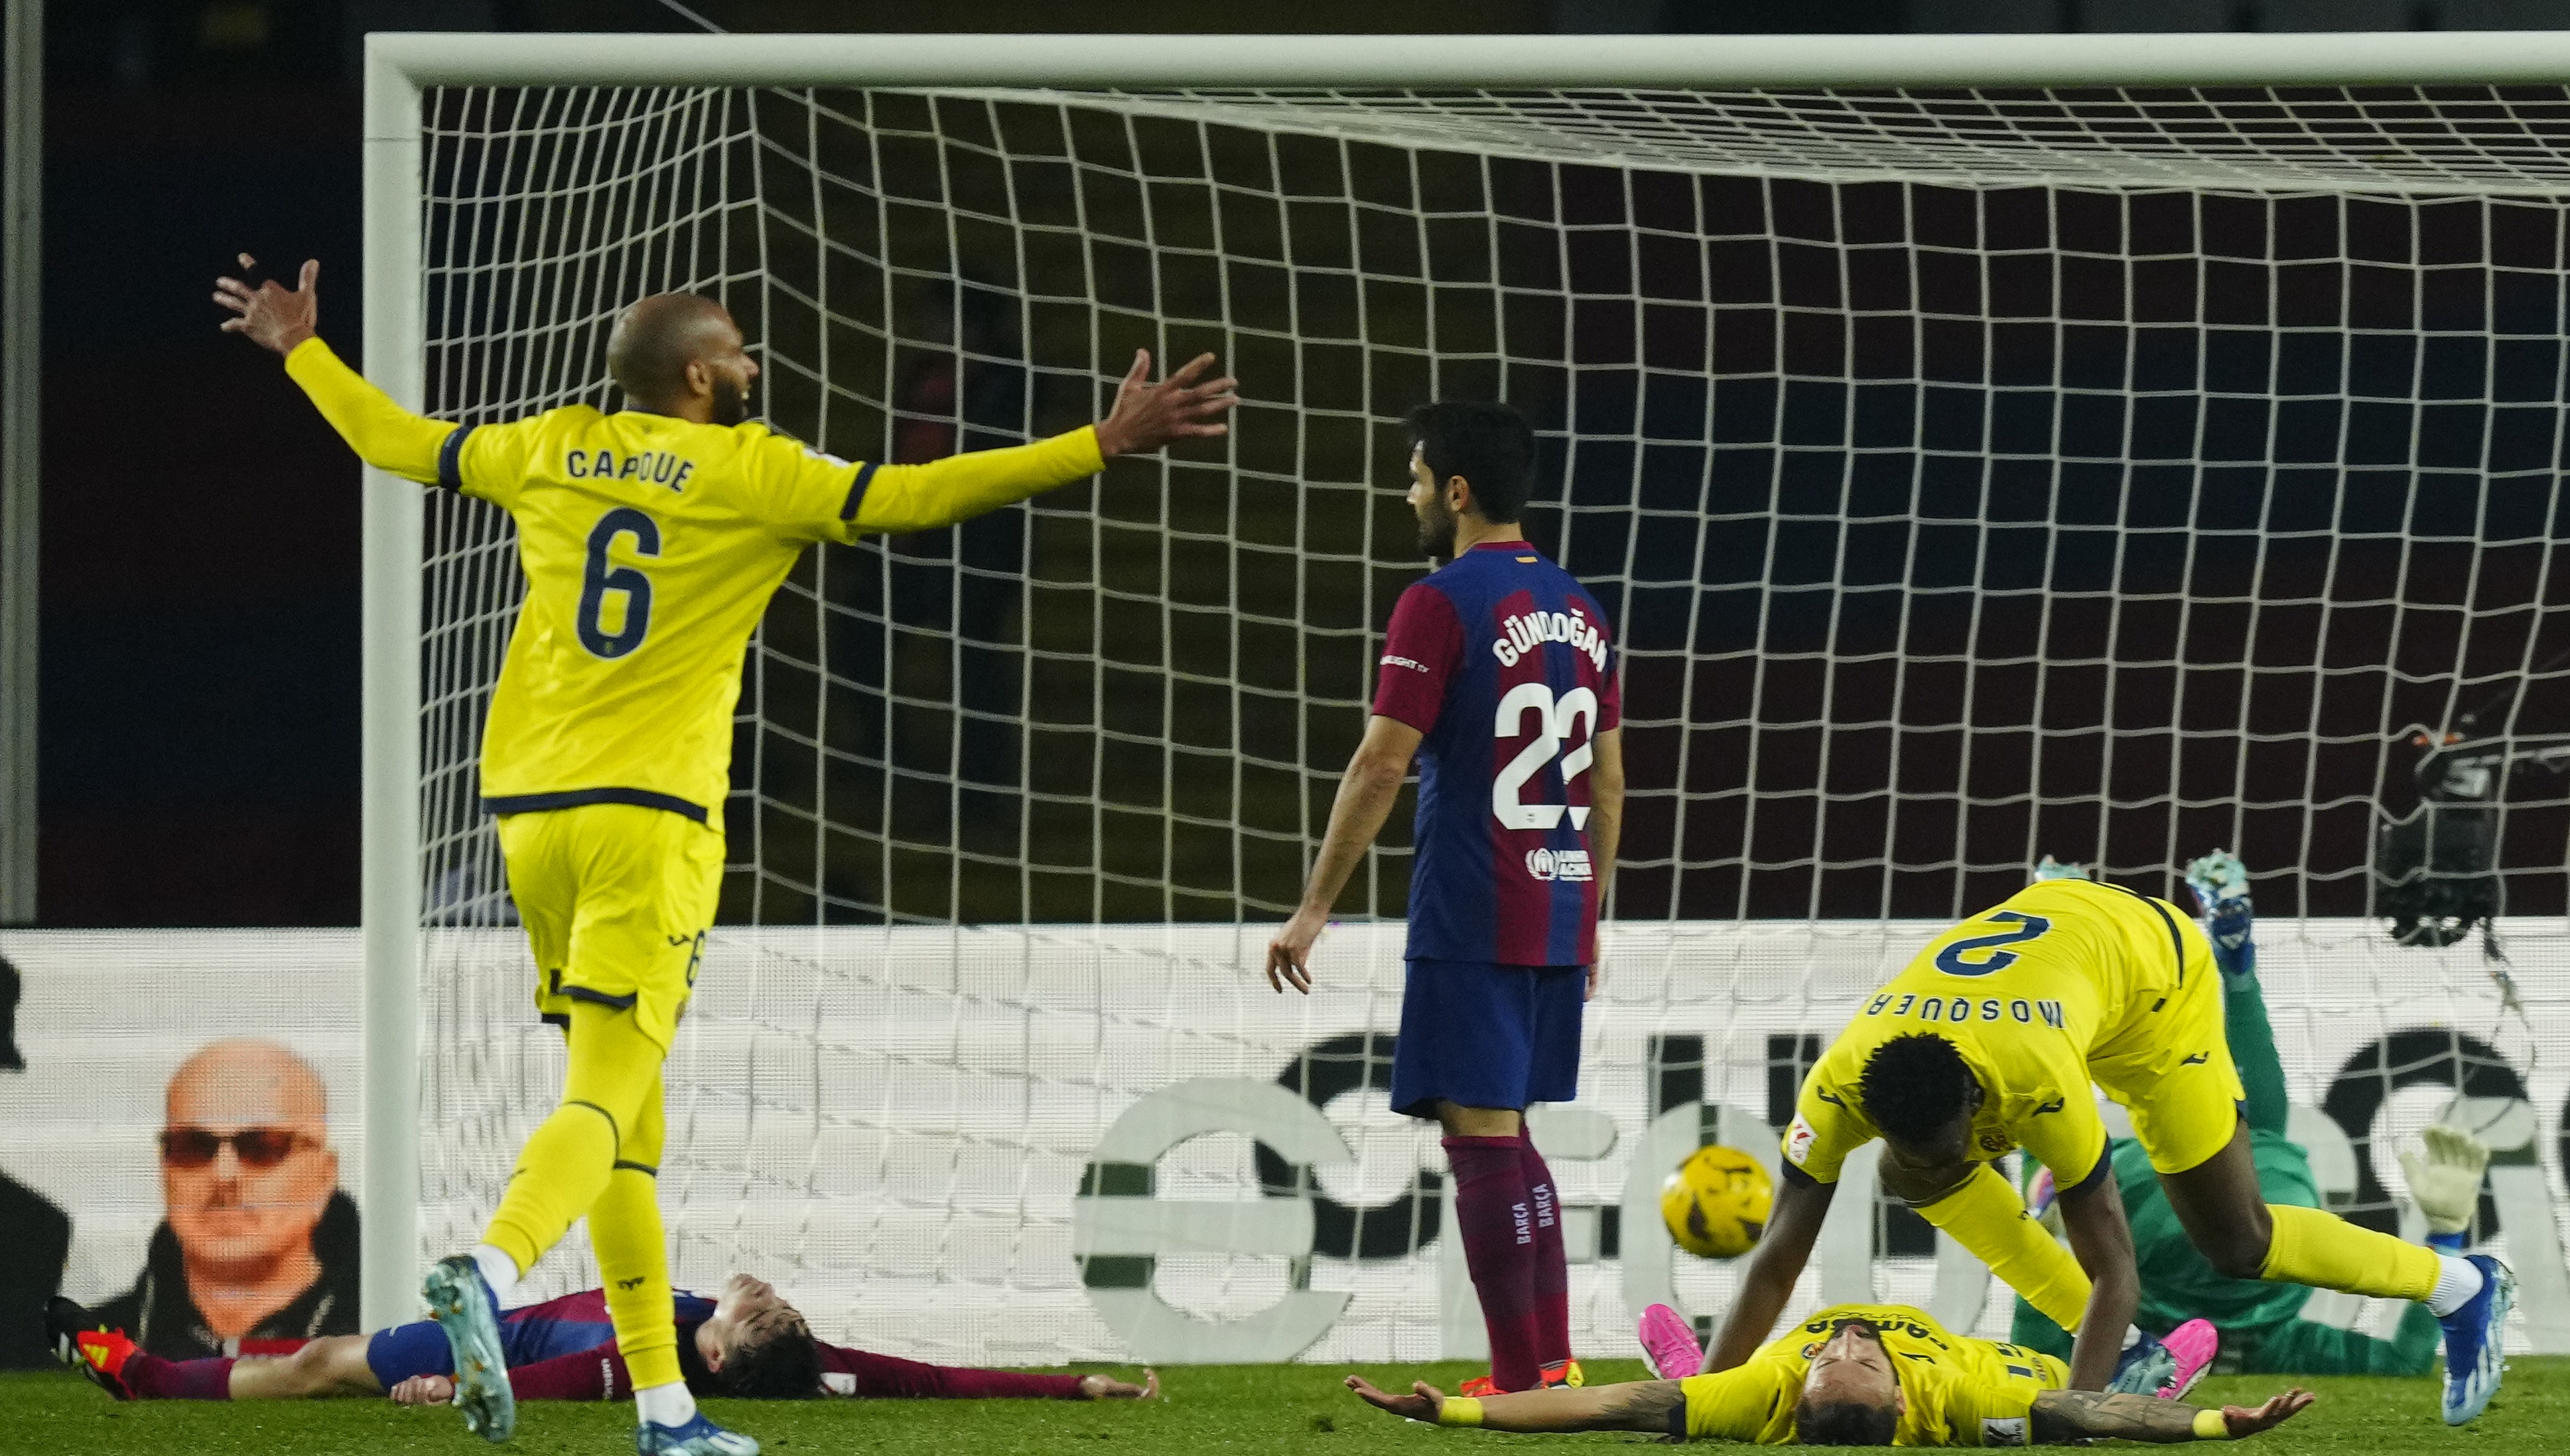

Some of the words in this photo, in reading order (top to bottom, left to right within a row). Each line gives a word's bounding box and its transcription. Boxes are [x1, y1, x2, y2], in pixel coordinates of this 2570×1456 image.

[567, 449, 694, 494] CAPOUE
[576, 506, 661, 659] 6
[1492, 607, 1609, 673] GÜNDOĞAN
[1491, 682, 1598, 831] 22
[1934, 910, 2051, 976] 2
[1511, 1201, 1532, 1245] BARÇA
[1531, 1183, 1555, 1228] BARÇA
